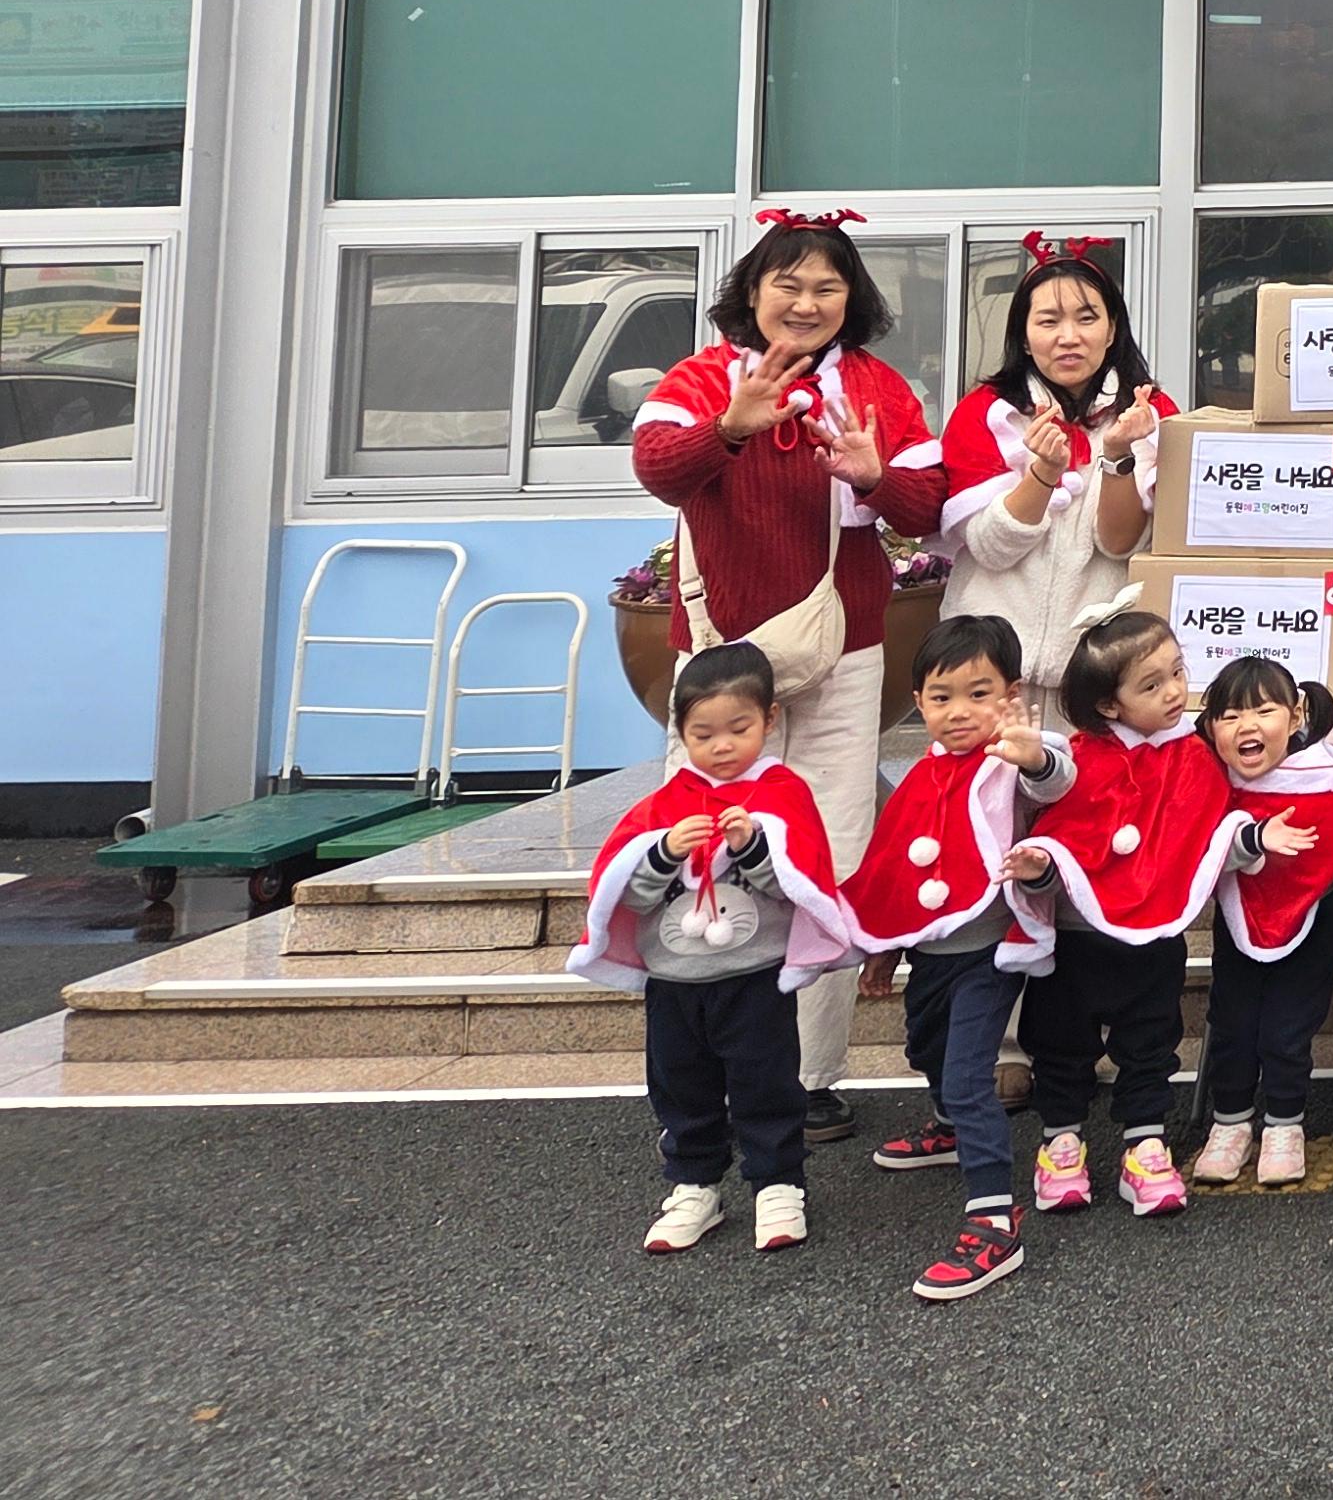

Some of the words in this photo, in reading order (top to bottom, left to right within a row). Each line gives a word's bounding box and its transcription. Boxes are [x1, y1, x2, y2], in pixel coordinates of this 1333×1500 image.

[1202, 463, 1265, 491] 사랑을
[1182, 606, 1246, 636] 사랑을
[1257, 608, 1319, 633] 나눠요
